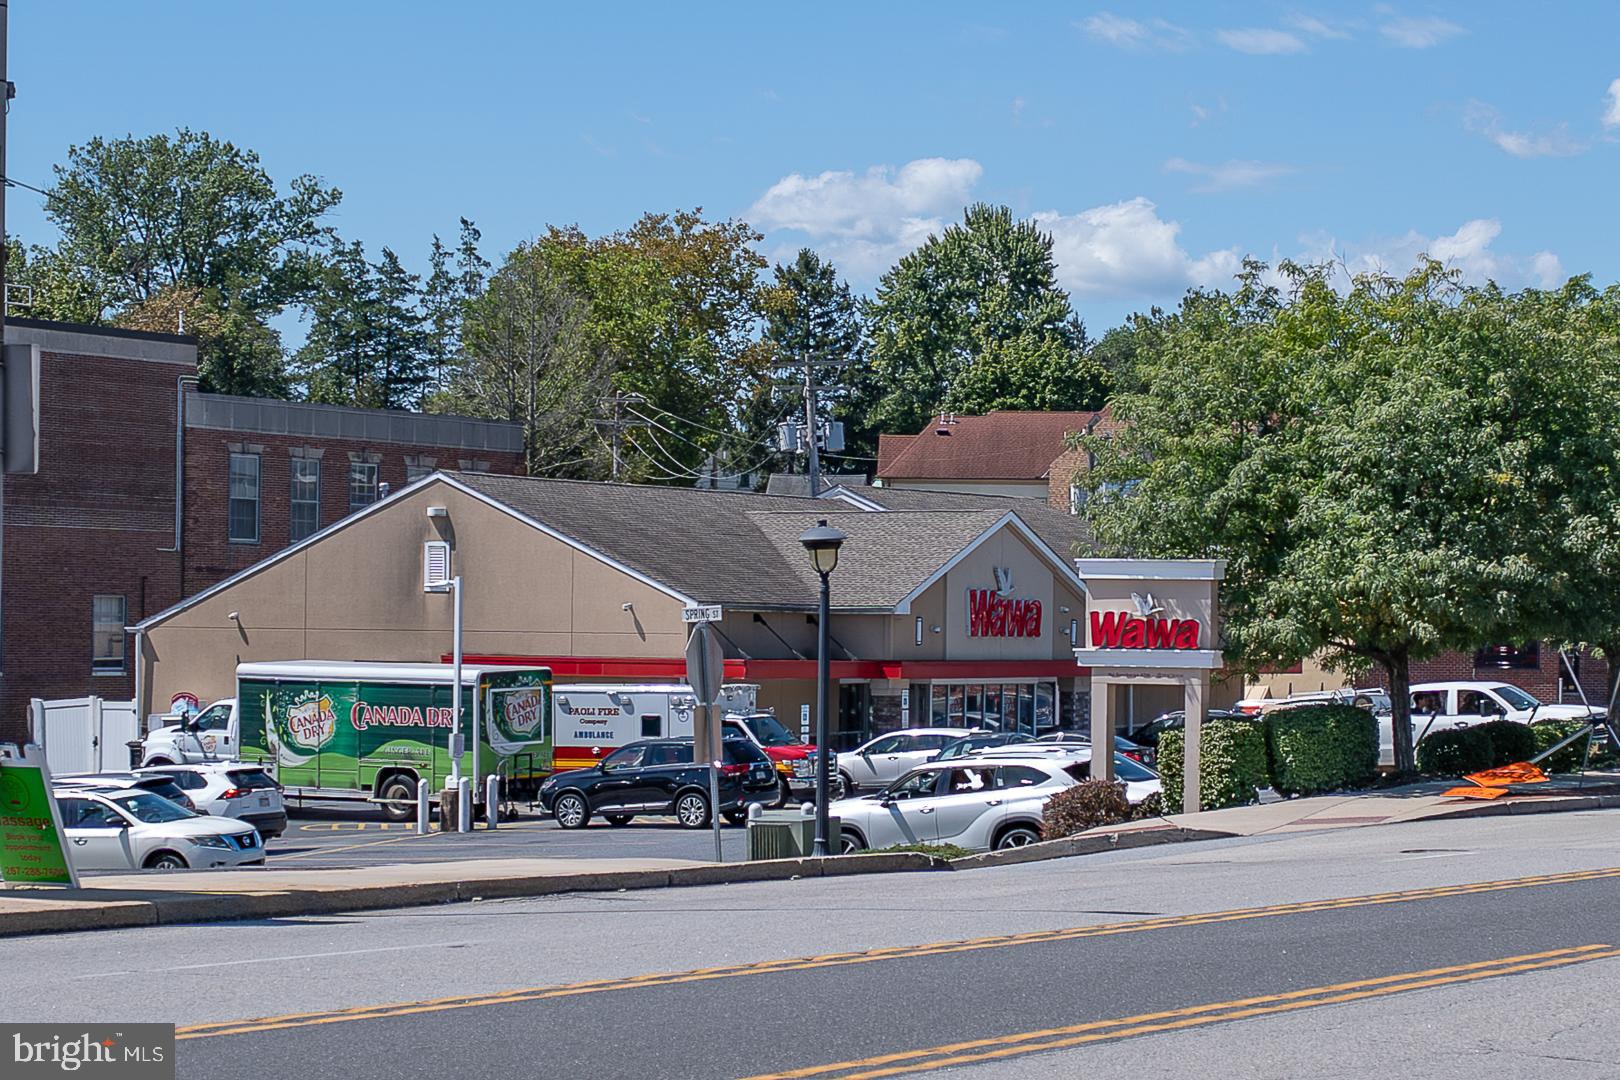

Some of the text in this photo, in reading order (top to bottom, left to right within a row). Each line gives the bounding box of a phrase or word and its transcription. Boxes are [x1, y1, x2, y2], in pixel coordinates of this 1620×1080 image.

[685, 608, 719, 620] SPRING ST
[968, 588, 1042, 638] Wawa
[1090, 610, 1200, 650] Wawa
[351, 701, 464, 730] CANADA DR
[517, 707, 537, 727] DRY
[569, 707, 620, 716] PAOLI FIRE
[289, 709, 336, 734] CANADA
[579, 718, 608, 726] Company
[303, 722, 325, 740] DRY
[573, 731, 615, 739] AMBULANCE
[0, 816, 49, 831] assage
